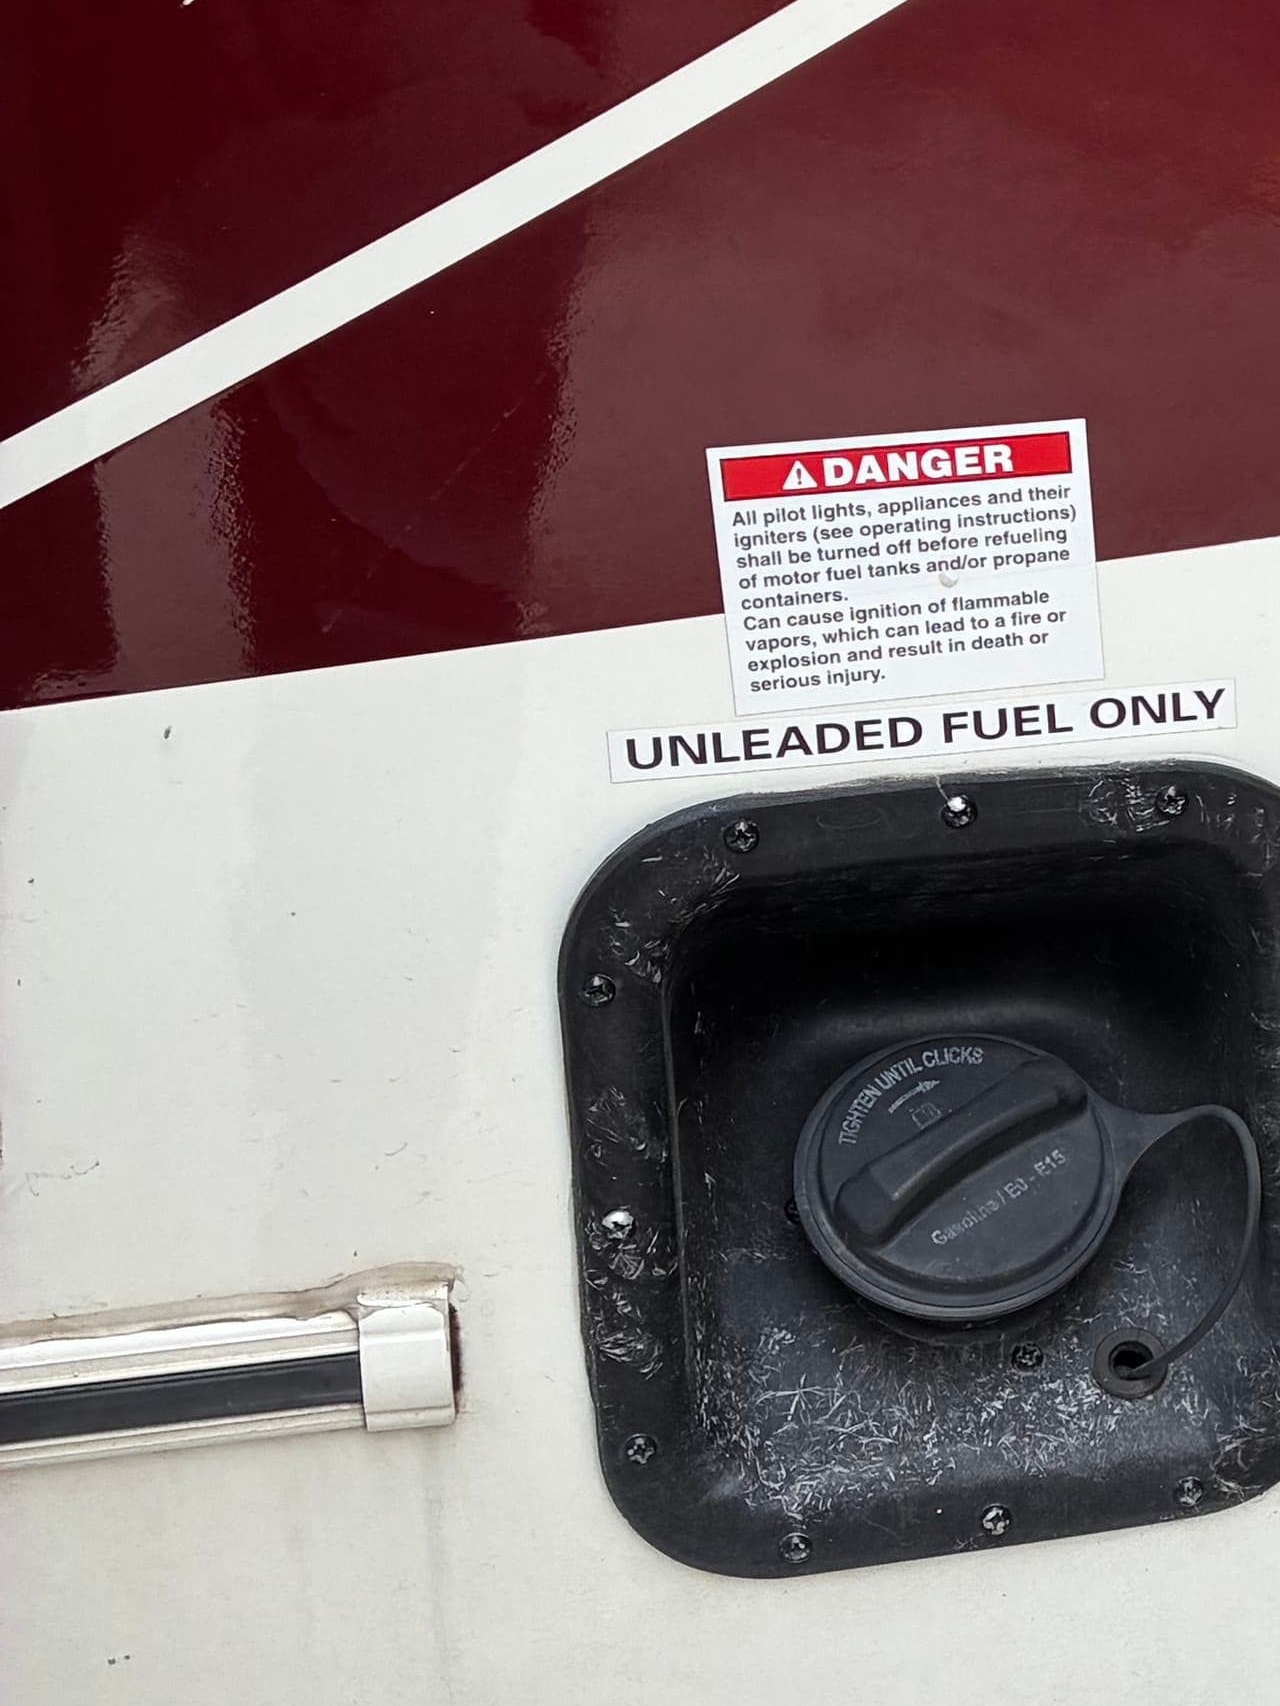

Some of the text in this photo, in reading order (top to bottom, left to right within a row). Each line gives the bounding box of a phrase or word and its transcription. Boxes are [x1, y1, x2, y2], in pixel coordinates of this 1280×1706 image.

[822, 443, 1014, 487] DANGER
[732, 485, 1072, 528] All pilot lights, appliances and their
[734, 504, 1077, 550] igniters (see operating instructions)
[736, 528, 1068, 569] shall be turned off before refueling
[739, 547, 1071, 589] of motor fuel tanks and/or propane
[741, 590, 849, 611] containers.
[743, 590, 1050, 631] Can cause ignition of flammable
[746, 610, 1067, 654] vapors, which can lead to a fire or
[747, 631, 1049, 673] explosion and result in death or
[750, 668, 886, 692] serious injury.
[626, 688, 1226, 770] UNLEADED FUEL ONLY
[838, 1046, 984, 1145] TIGHTEN UNTIL CLICKS
[1034, 1149, 1066, 1178] E15
